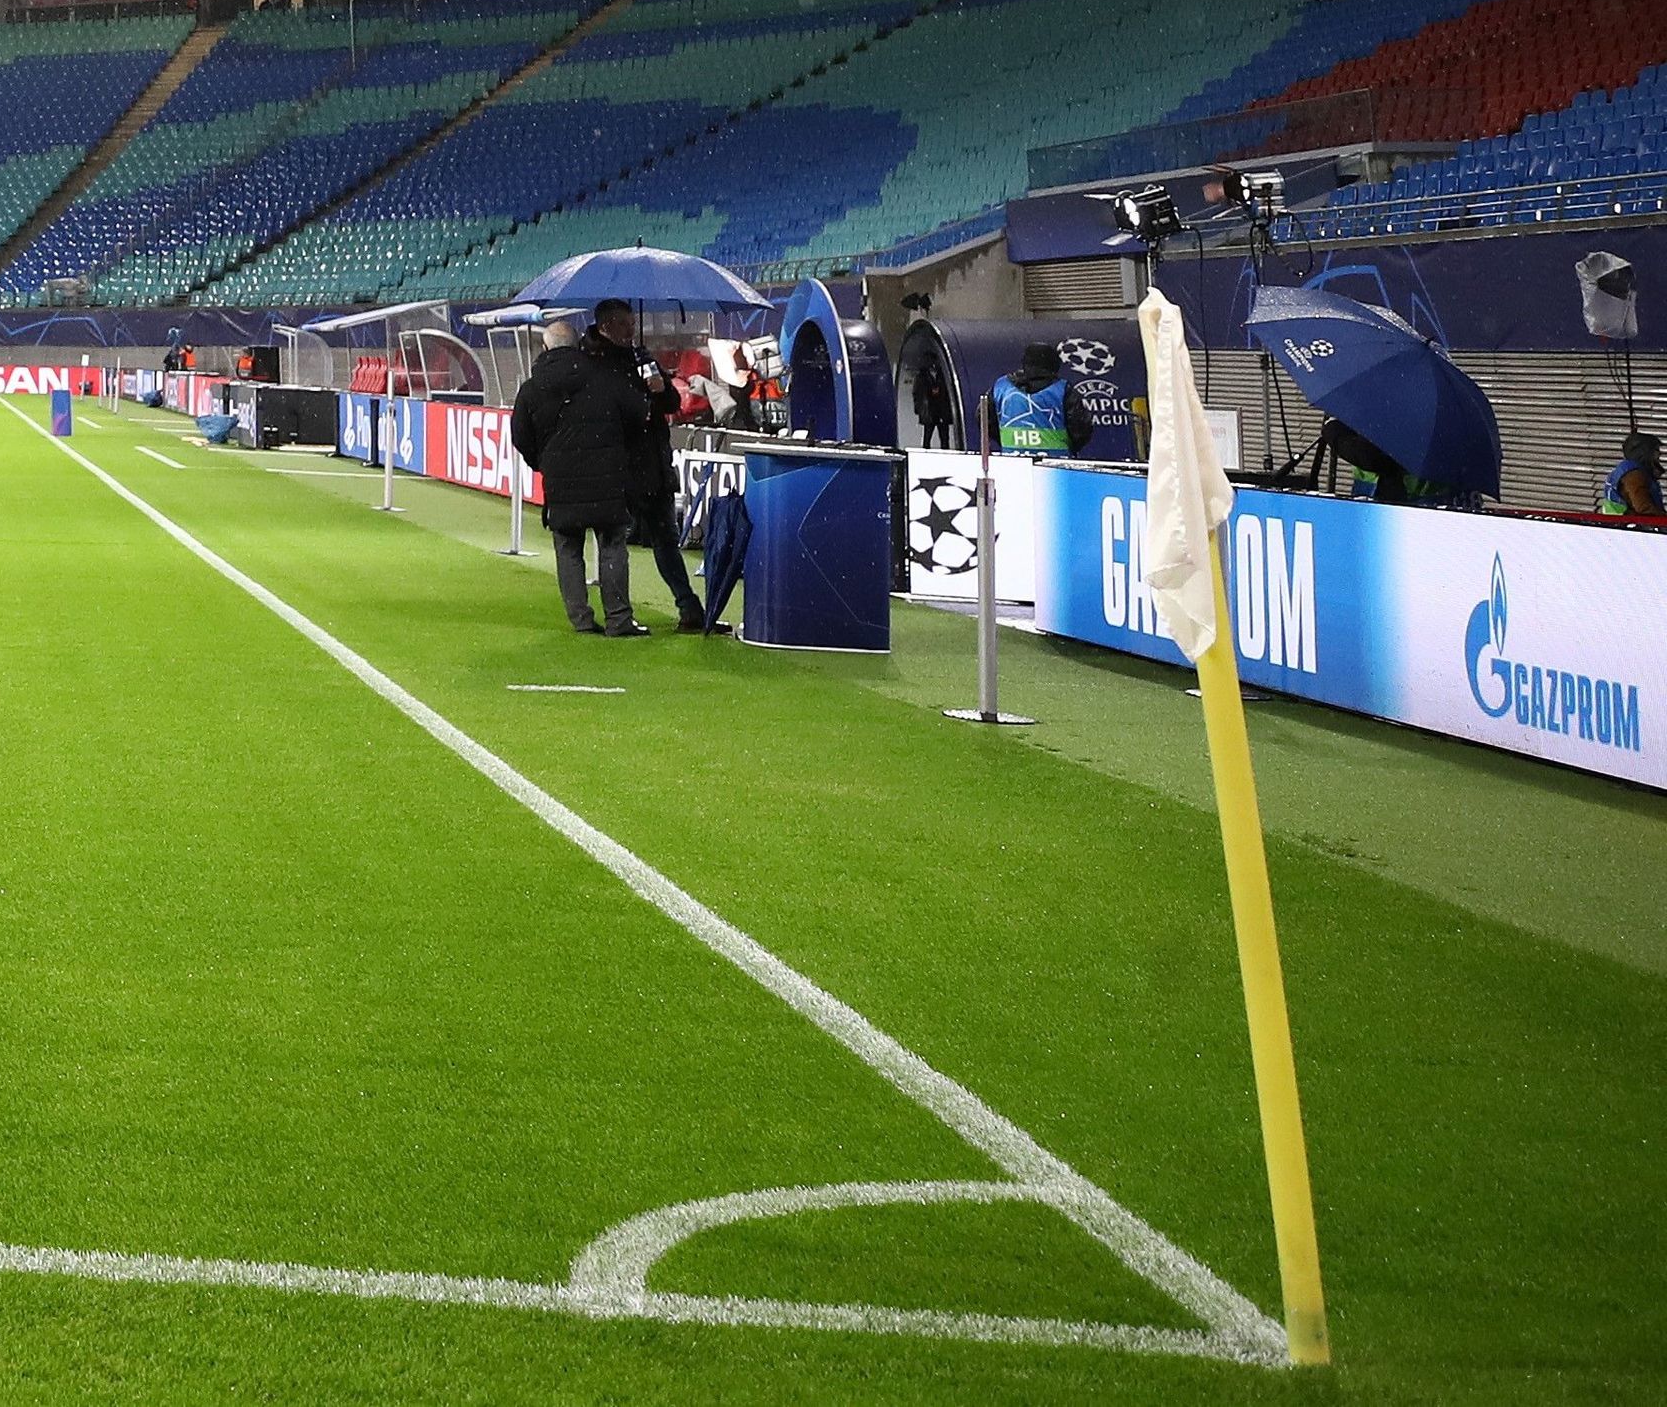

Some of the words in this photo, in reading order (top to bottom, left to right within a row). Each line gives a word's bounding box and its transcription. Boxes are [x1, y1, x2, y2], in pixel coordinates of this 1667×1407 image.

[1076, 382, 1116, 396] UEFA
[1013, 430, 1041, 445] HB
[1101, 496, 1317, 674] GAOM
[1514, 663, 1640, 752] GAZPROM
